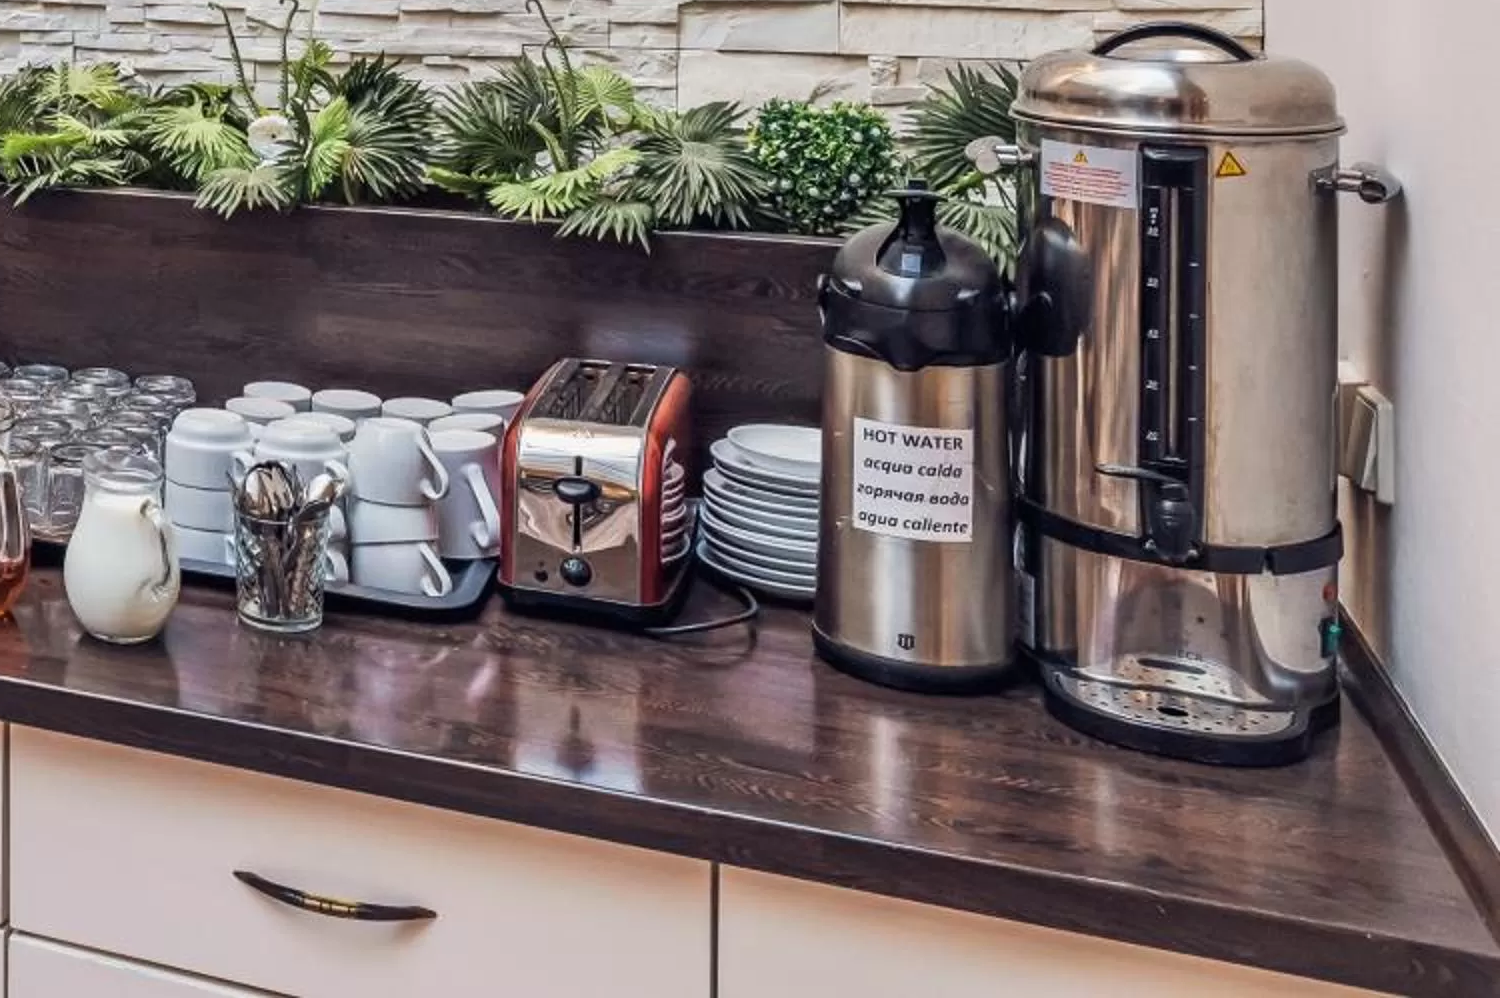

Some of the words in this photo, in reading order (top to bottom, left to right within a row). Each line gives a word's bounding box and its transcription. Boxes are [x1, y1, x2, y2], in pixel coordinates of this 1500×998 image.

[863, 428, 897, 444] HOT
[902, 434, 963, 450] WATER
[864, 458, 913, 474] acqua
[918, 463, 963, 478] calda
[857, 483, 925, 503] горячая
[929, 492, 970, 506] вода
[858, 511, 898, 527] agua
[903, 518, 968, 534] caliente
